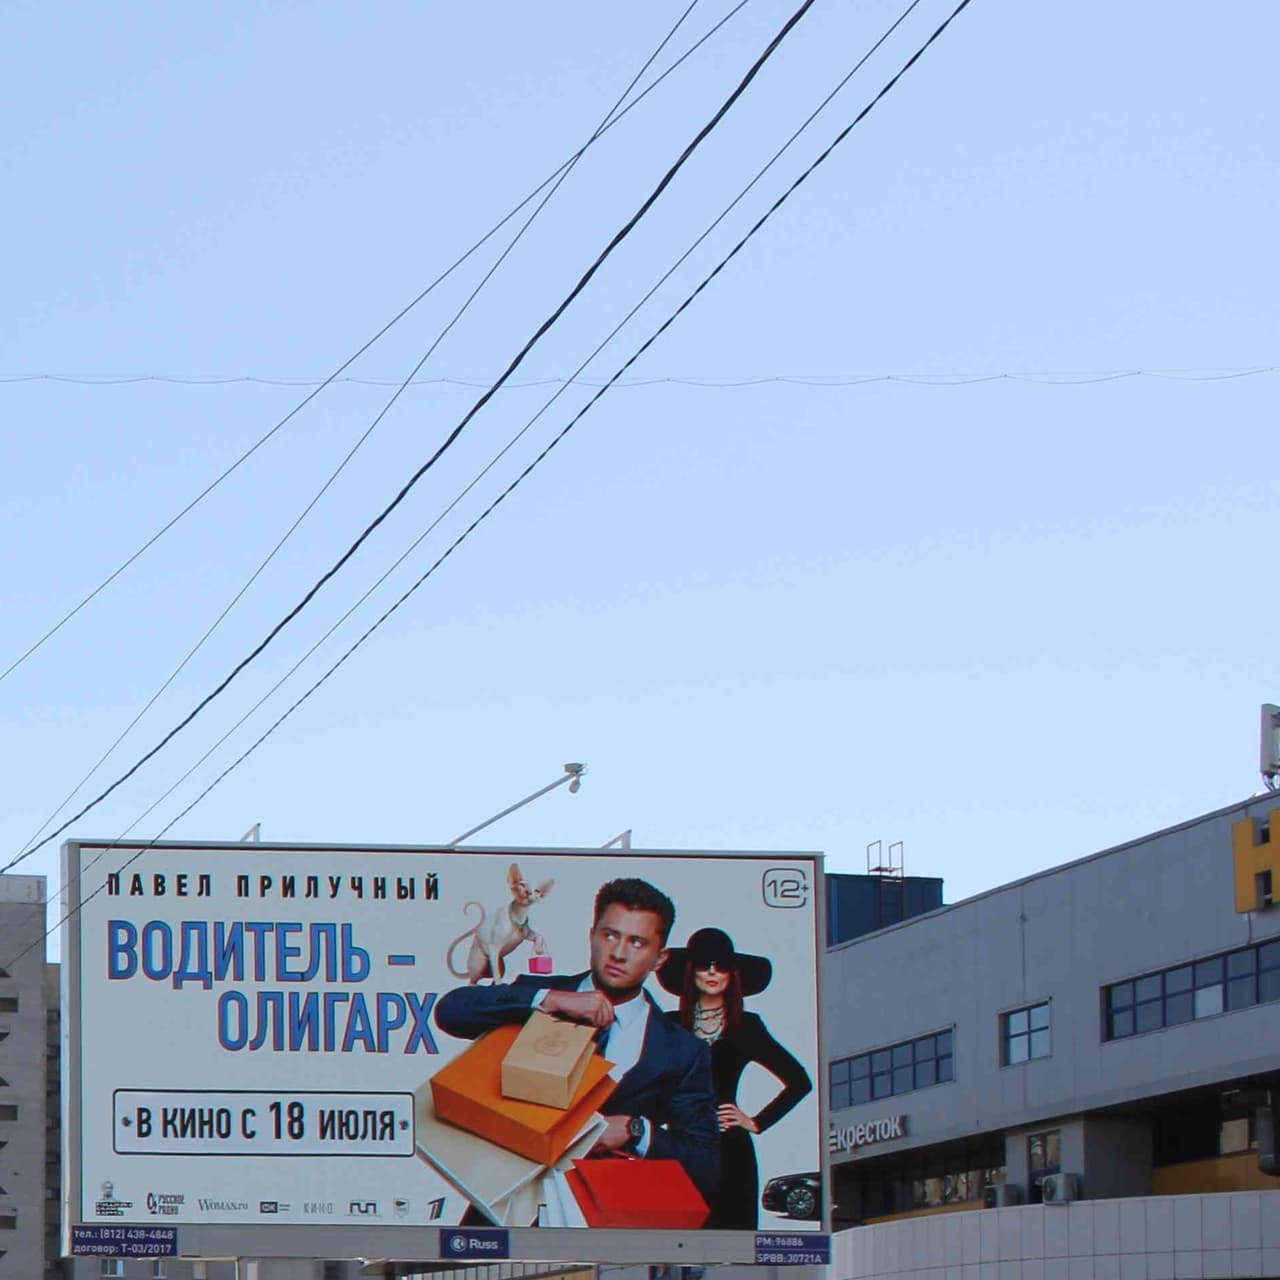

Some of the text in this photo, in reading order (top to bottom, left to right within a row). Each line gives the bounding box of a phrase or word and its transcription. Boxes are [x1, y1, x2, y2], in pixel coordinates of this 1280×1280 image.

[108, 872, 439, 900] ПАВЕЛ ПРИЛУЧНЫЙ
[767, 879, 809, 898] 12+
[107, 920, 371, 990] ВОДИТЕЛЬ
[217, 990, 440, 1054] ОЛИГАРХ
[136, 1107, 152, 1138] В
[162, 1107, 231, 1139] КИНО
[269, 1101, 304, 1140] 18
[319, 1109, 395, 1141] ИЮЛЯ
[469, 1239, 499, 1250] Russ
